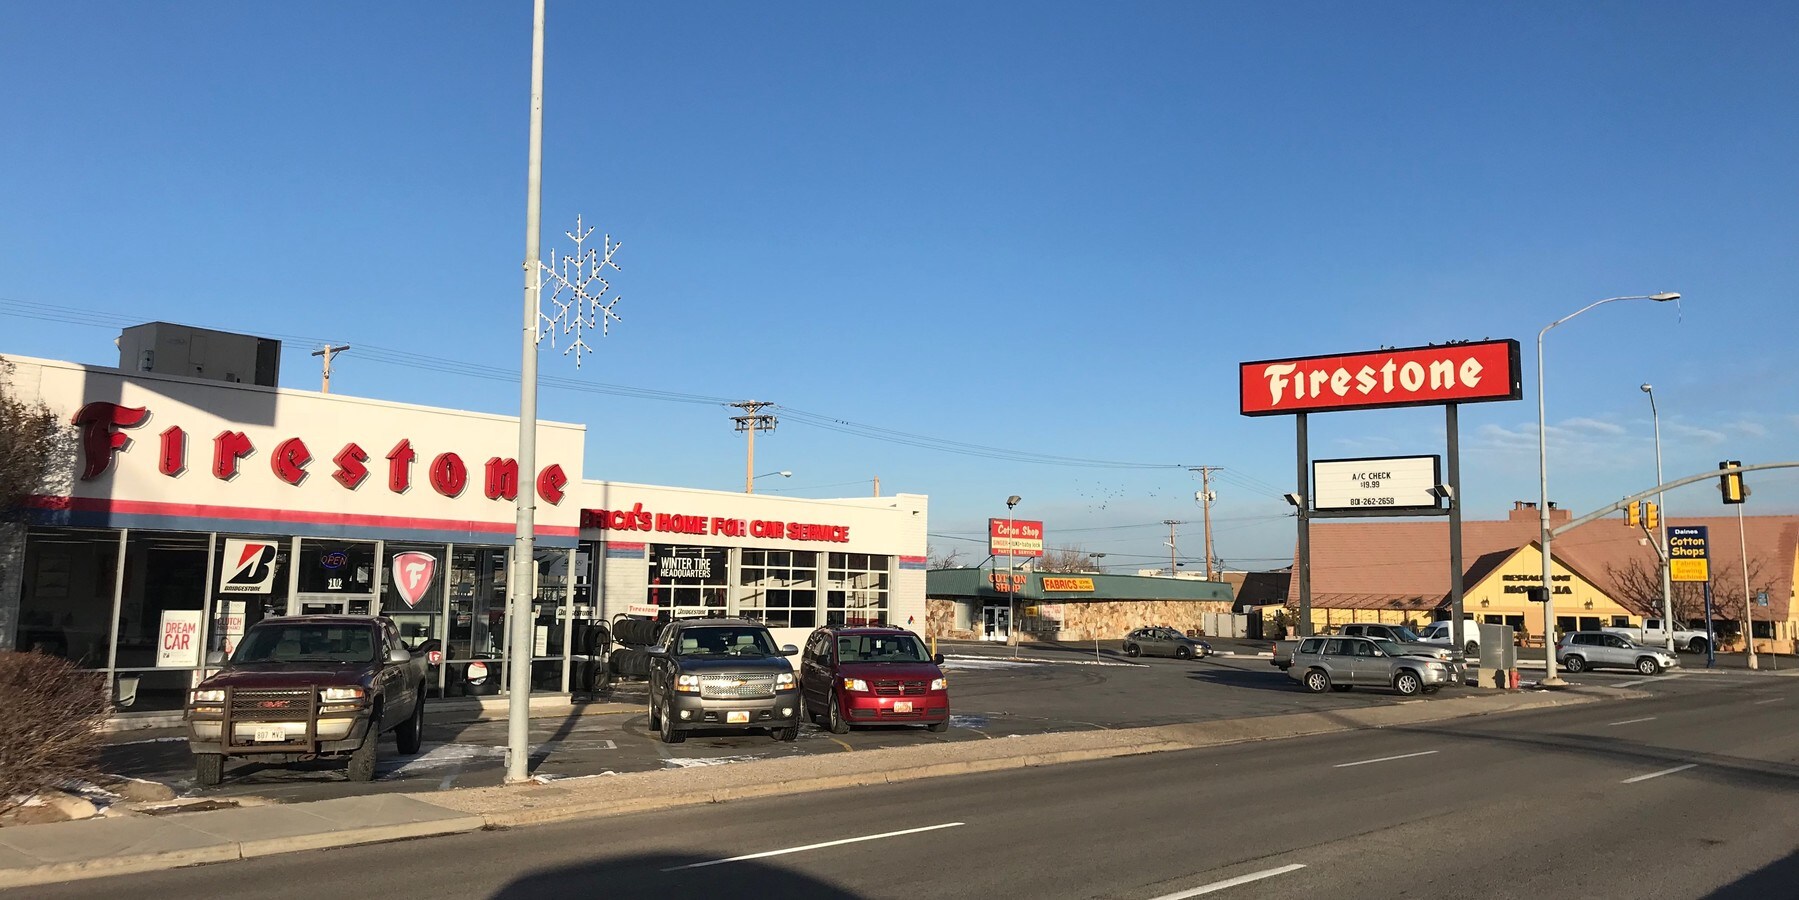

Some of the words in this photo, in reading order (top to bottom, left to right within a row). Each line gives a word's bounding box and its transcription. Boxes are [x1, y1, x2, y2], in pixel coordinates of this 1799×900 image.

[1264, 356, 1484, 406] Firestone
[70, 401, 569, 506] Firestone
[1352, 472, 1366, 480] A/C
[1368, 471, 1391, 480] CHECK
[1360, 480, 1380, 488] $19.99
[1350, 497, 1395, 506] 801-262-2658
[655, 512, 708, 535] HOME
[711, 517, 747, 538] FOR
[749, 519, 785, 539] CAR
[786, 521, 850, 543] SERVICE
[1021, 525, 1040, 539] Shop
[1670, 537, 1705, 546] Cotton
[1671, 546, 1705, 557] Shops
[320, 555, 347, 566] OPEN
[661, 556, 692, 570] WINTER
[693, 557, 711, 570] TIRE
[660, 568, 711, 578] HEADQUARTERS
[1044, 579, 1078, 590] FABRICS
[628, 604, 658, 614] Firestone
[677, 607, 707, 616] BRIDGESTONE
[165, 622, 196, 634] DREAM
[164, 633, 190, 650] CAR
